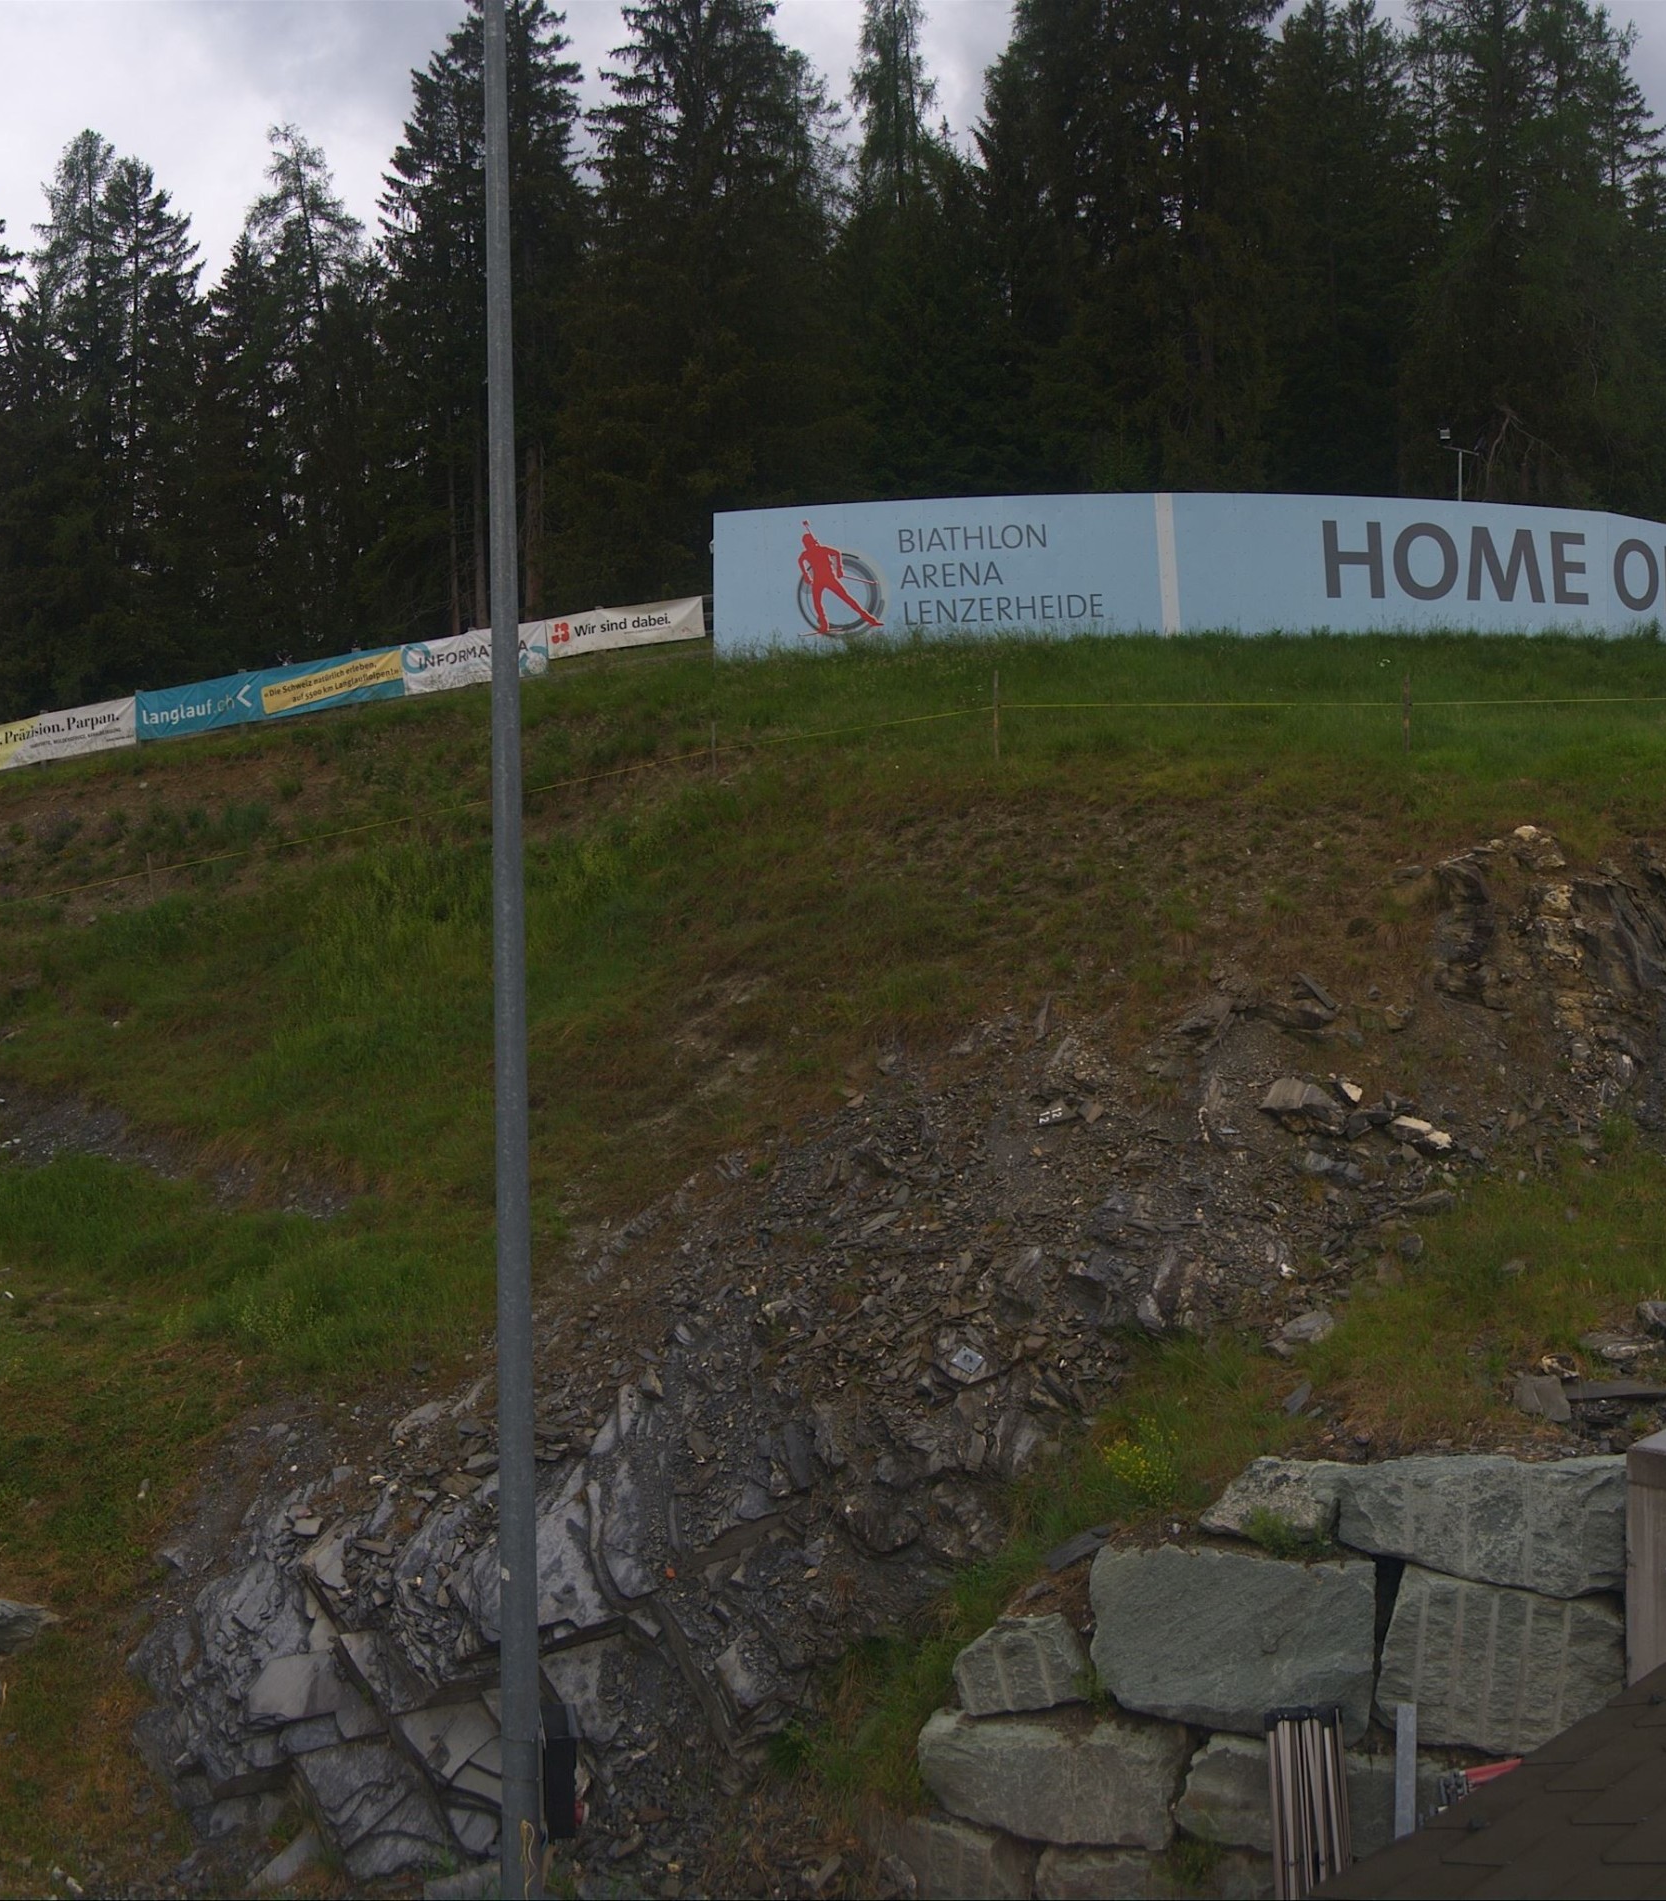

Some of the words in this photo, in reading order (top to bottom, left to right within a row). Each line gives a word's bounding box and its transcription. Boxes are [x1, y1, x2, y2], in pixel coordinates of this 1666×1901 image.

[897, 523, 1048, 554] BIATHLON
[900, 561, 1004, 590] ARENA
[1322, 519, 1590, 605] HOME
[574, 623, 597, 637] Wir
[600, 617, 627, 633] sind
[631, 612, 672, 629] dabei.
[903, 593, 1104, 626] LENZERHEIDE
[418, 639, 529, 671] INFORMAA
[282, 680, 312, 693] Schweiz
[313, 669, 345, 685] natürlich
[345, 661, 377, 676] erleben,
[141, 693, 236, 725] langlauf.ch
[292, 693, 304, 703] auf
[323, 685, 334, 693] km
[3, 720, 66, 745] Präzision.
[66, 710, 120, 731] Parpan.
